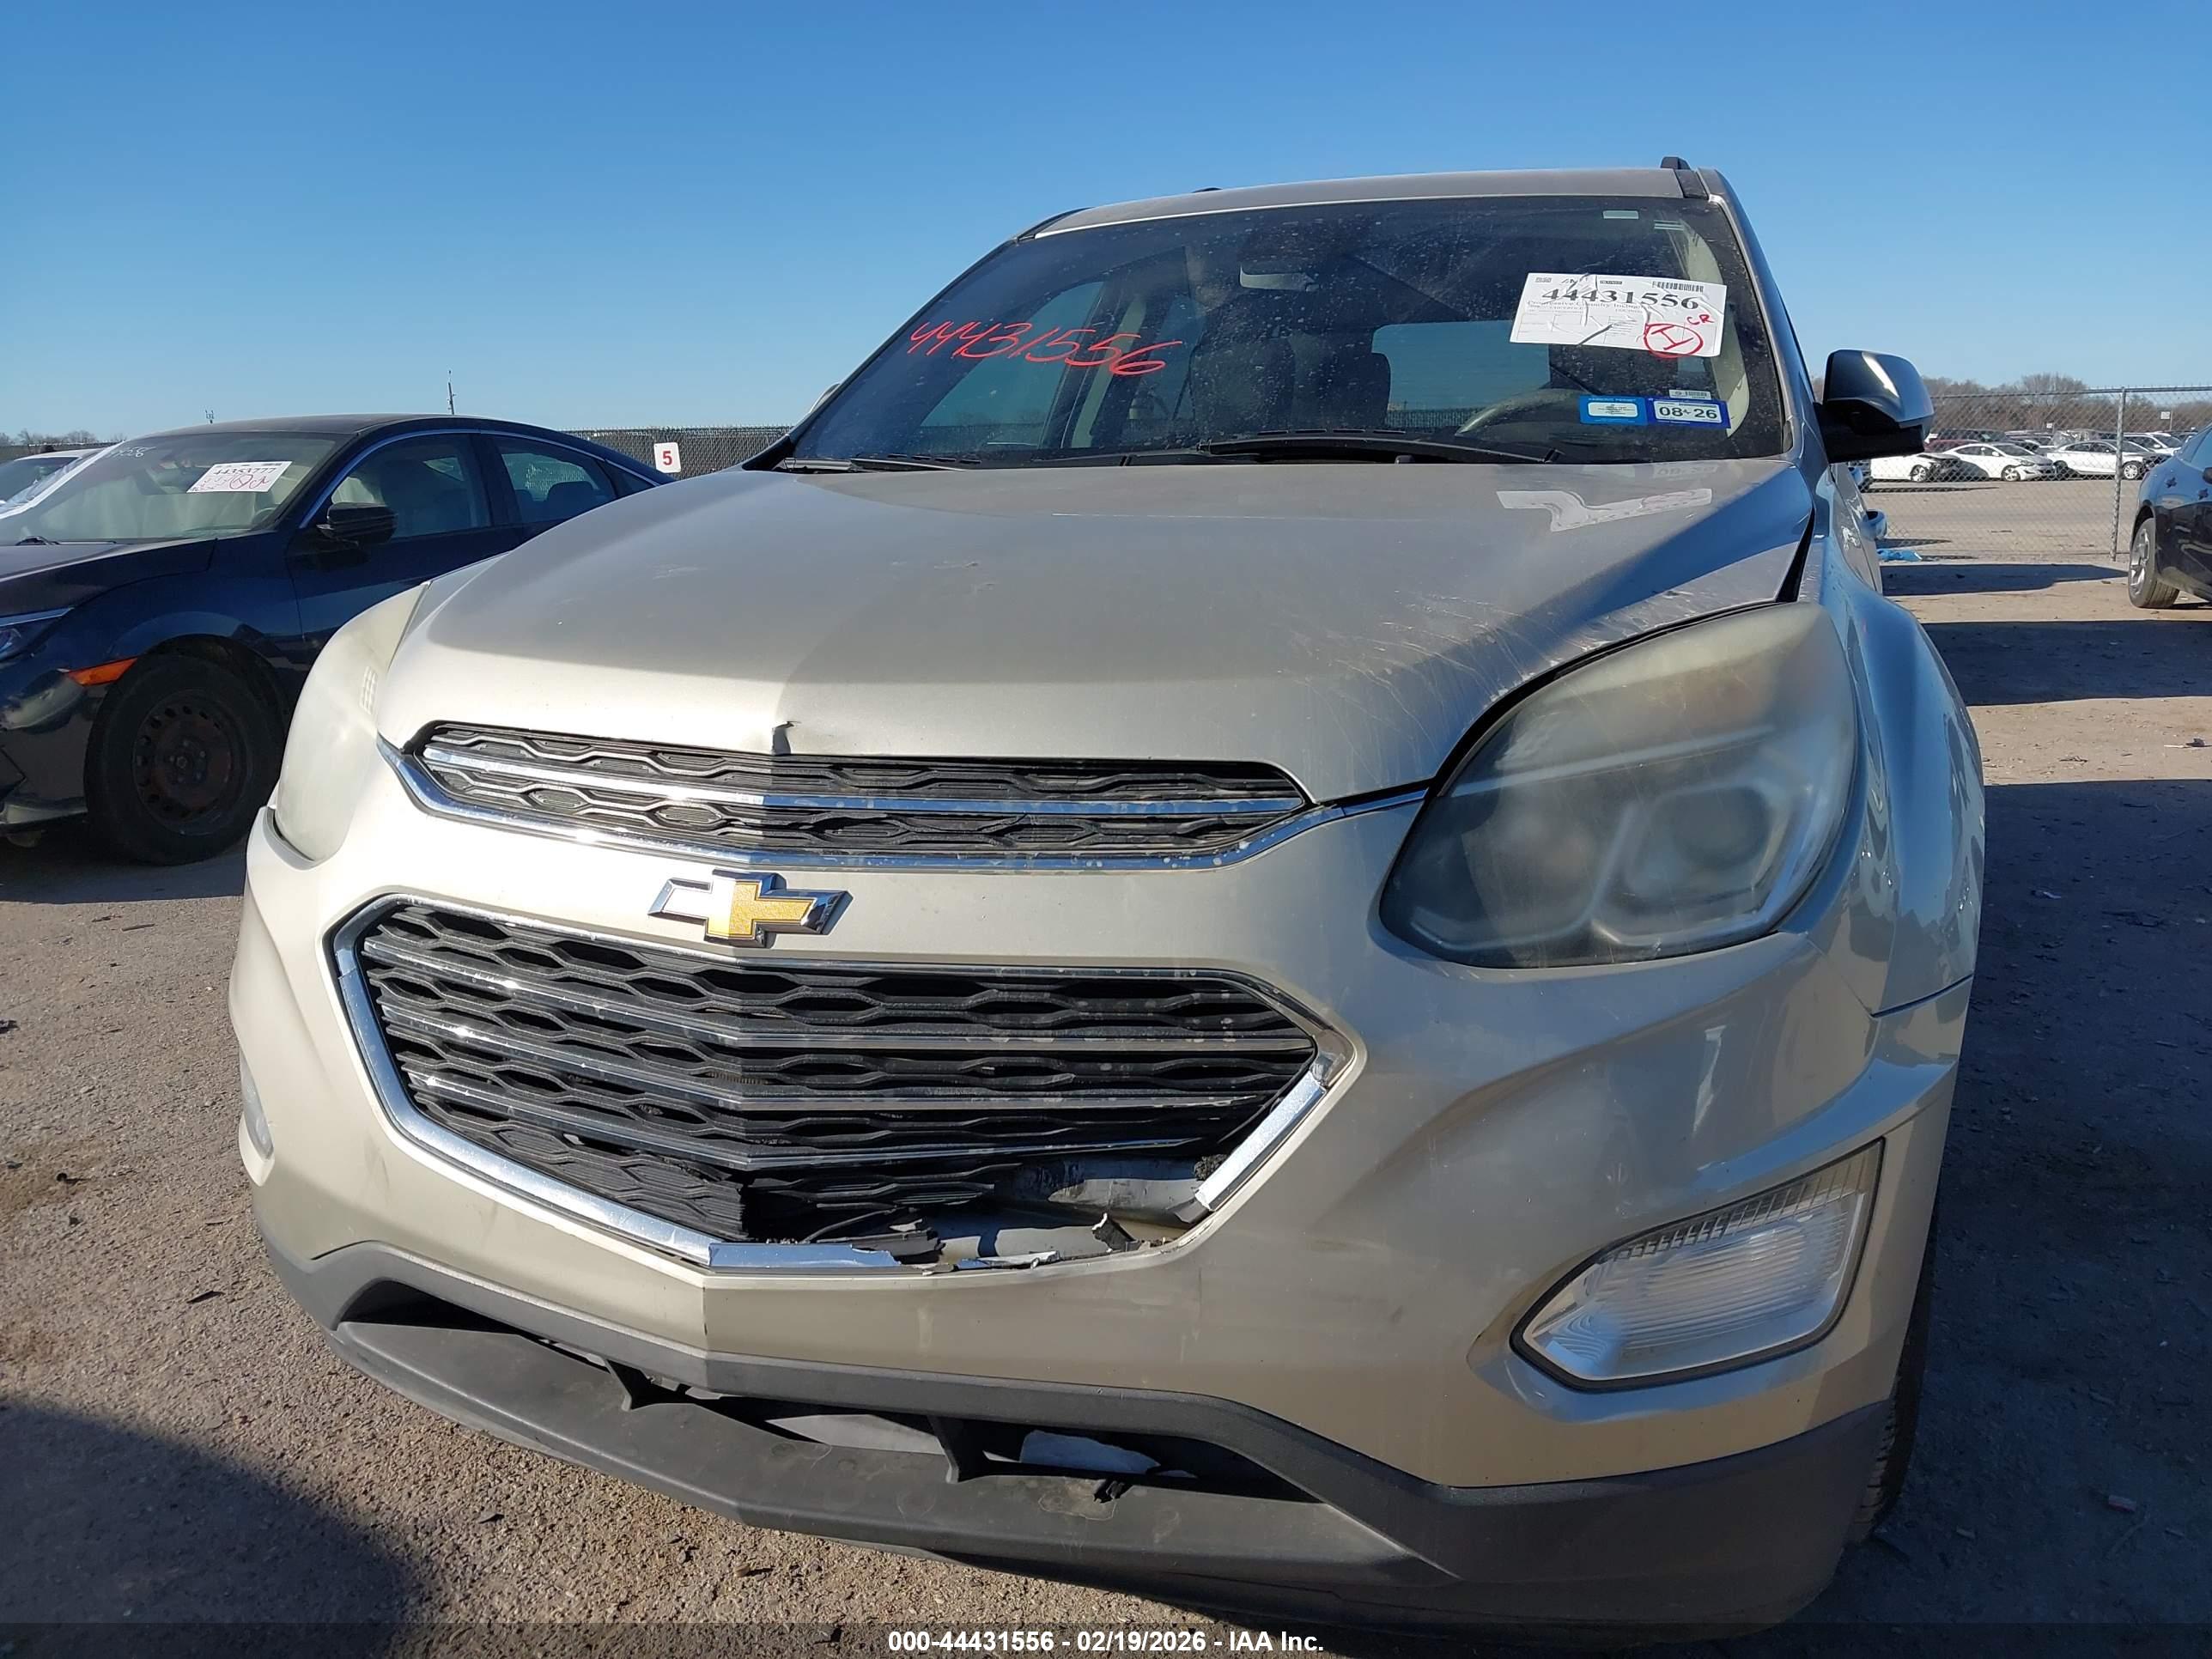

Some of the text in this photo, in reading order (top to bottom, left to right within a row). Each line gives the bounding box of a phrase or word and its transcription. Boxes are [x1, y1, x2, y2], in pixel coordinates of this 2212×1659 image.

[1541, 289, 1699, 310] 44431556
[907, 321, 1183, 375] 44431556
[1659, 406, 1717, 419] 08 26
[663, 450, 672, 466] 5
